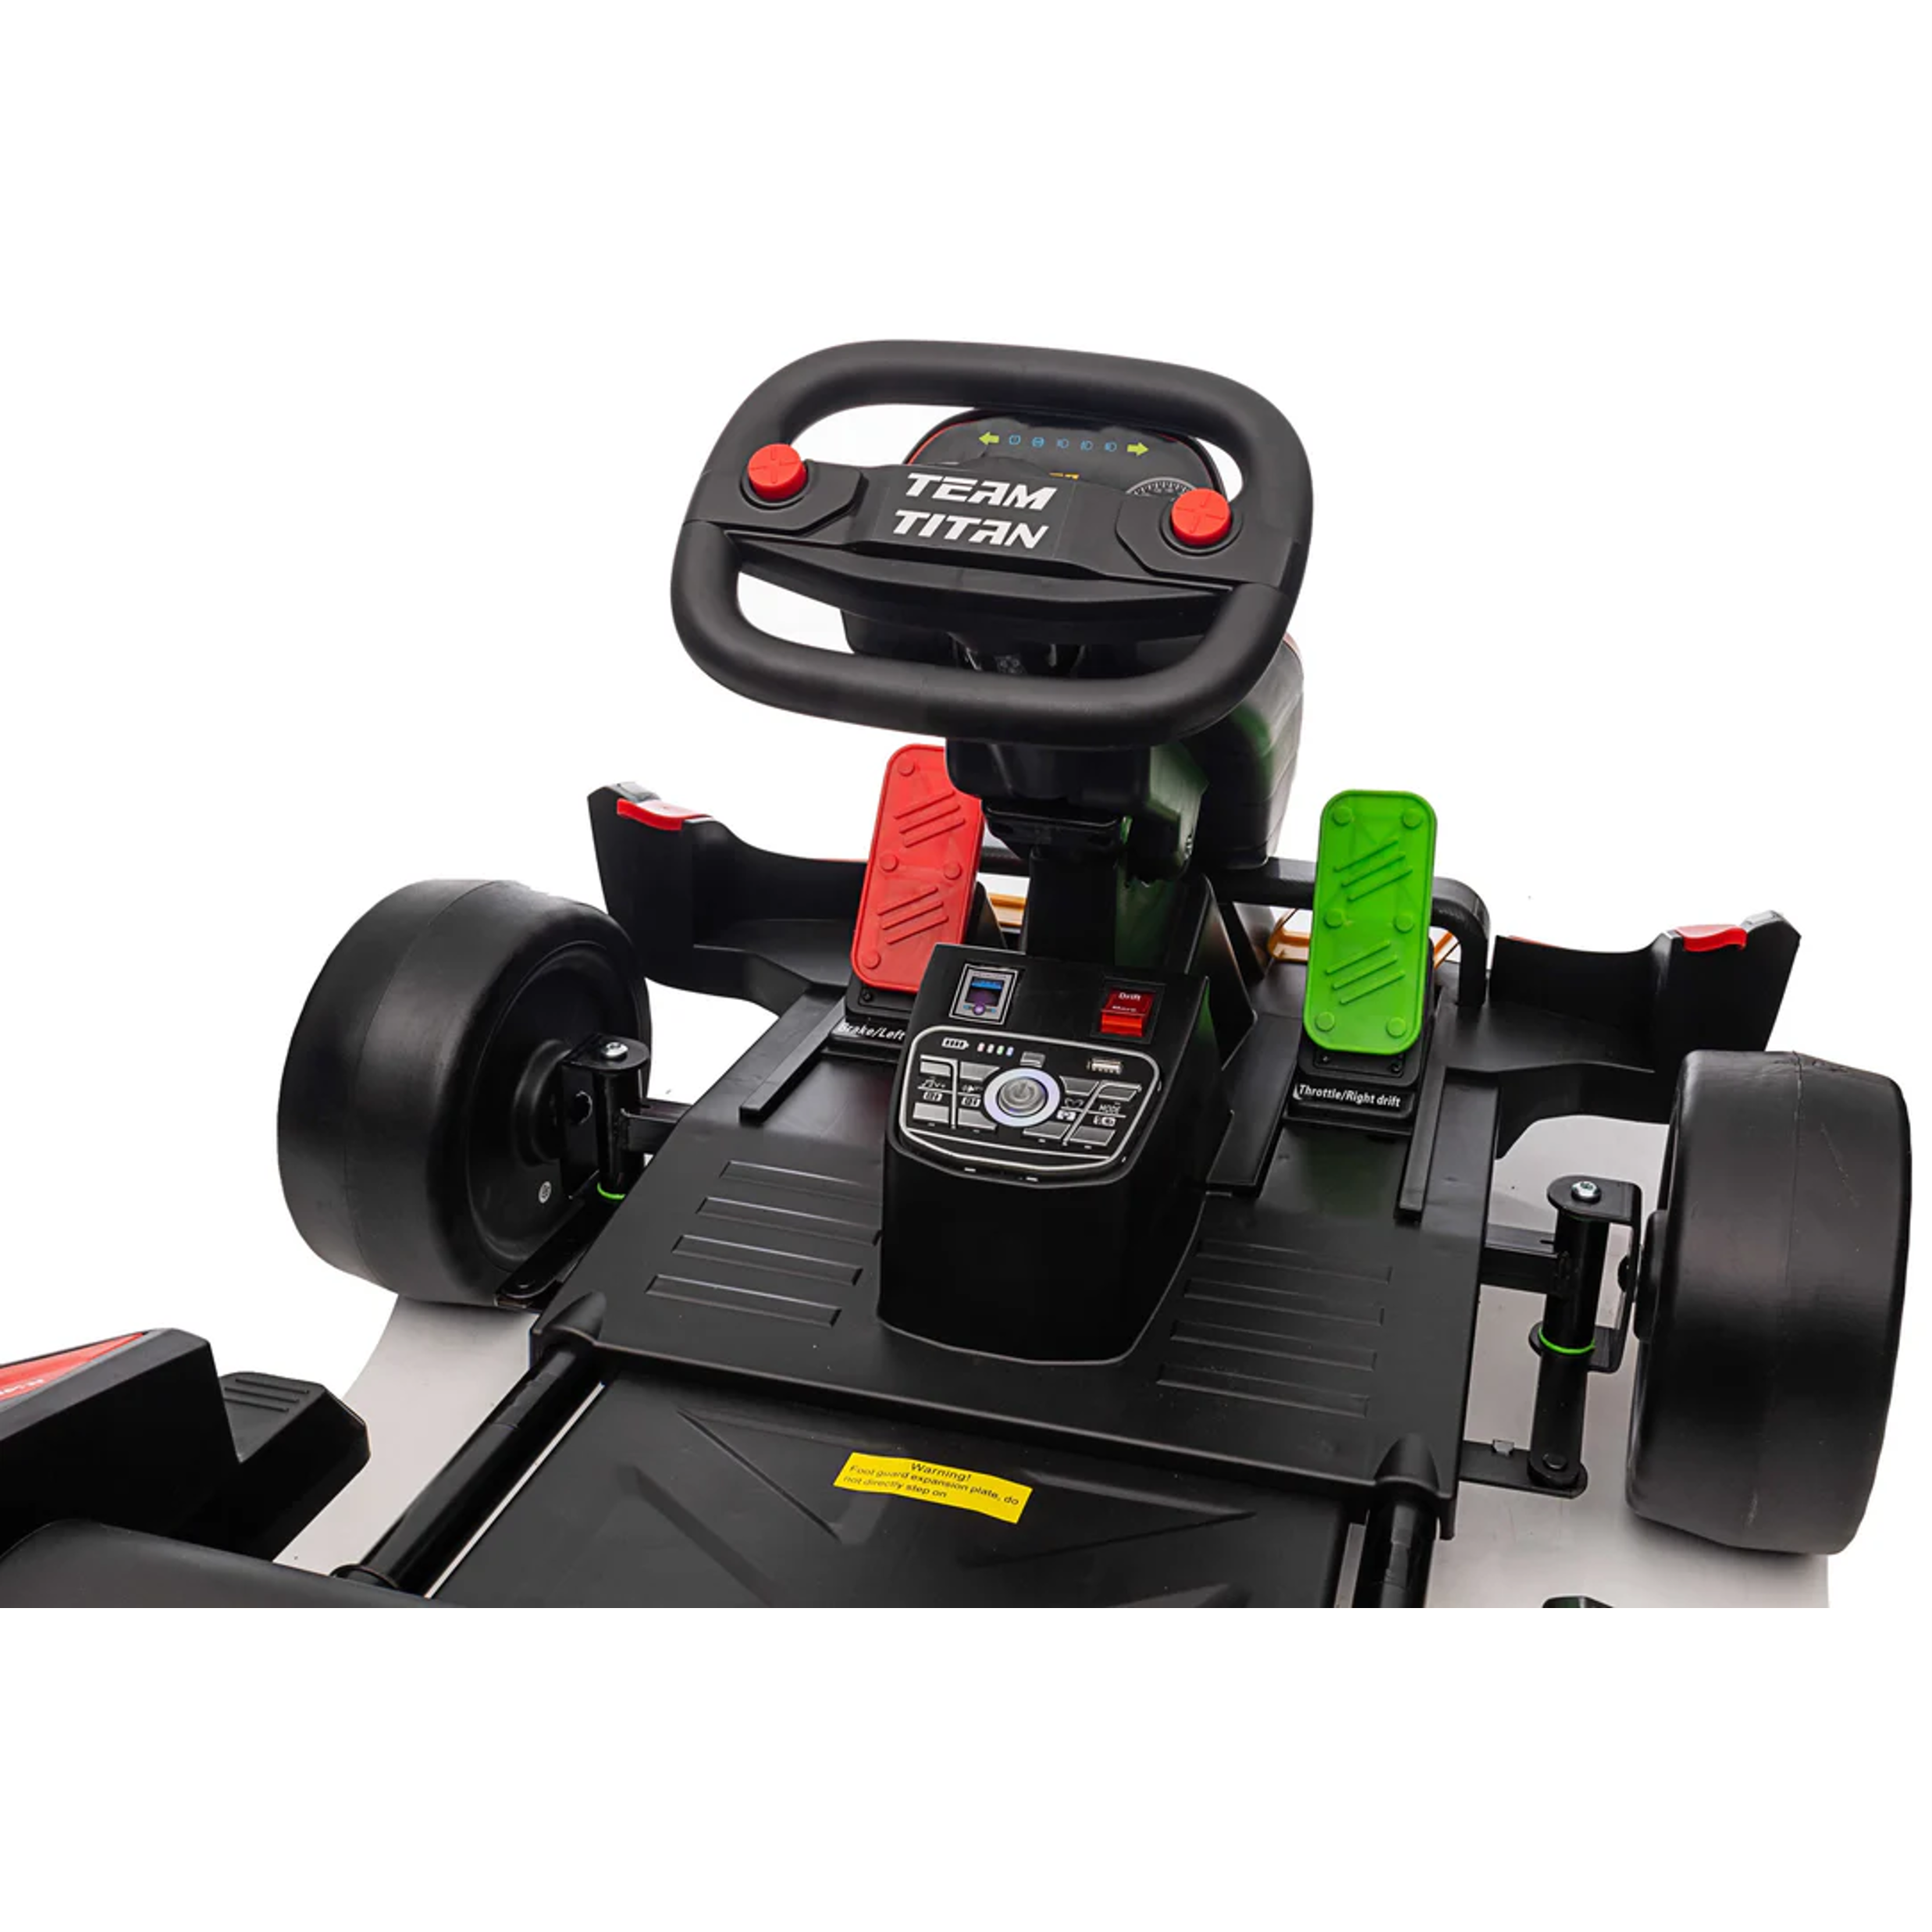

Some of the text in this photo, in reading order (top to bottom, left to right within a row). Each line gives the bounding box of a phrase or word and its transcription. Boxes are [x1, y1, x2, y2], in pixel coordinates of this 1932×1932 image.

[906, 472, 1057, 511] TEAM
[893, 509, 1049, 549] TITAN
[1119, 991, 1141, 1002] Drift
[1299, 1084, 1401, 1107] Throttle/Right drift
[910, 1462, 973, 1482] Warning!
[843, 1475, 947, 1498] not directly step on
[849, 1464, 1019, 1506] Foot guard expansion plate, do
